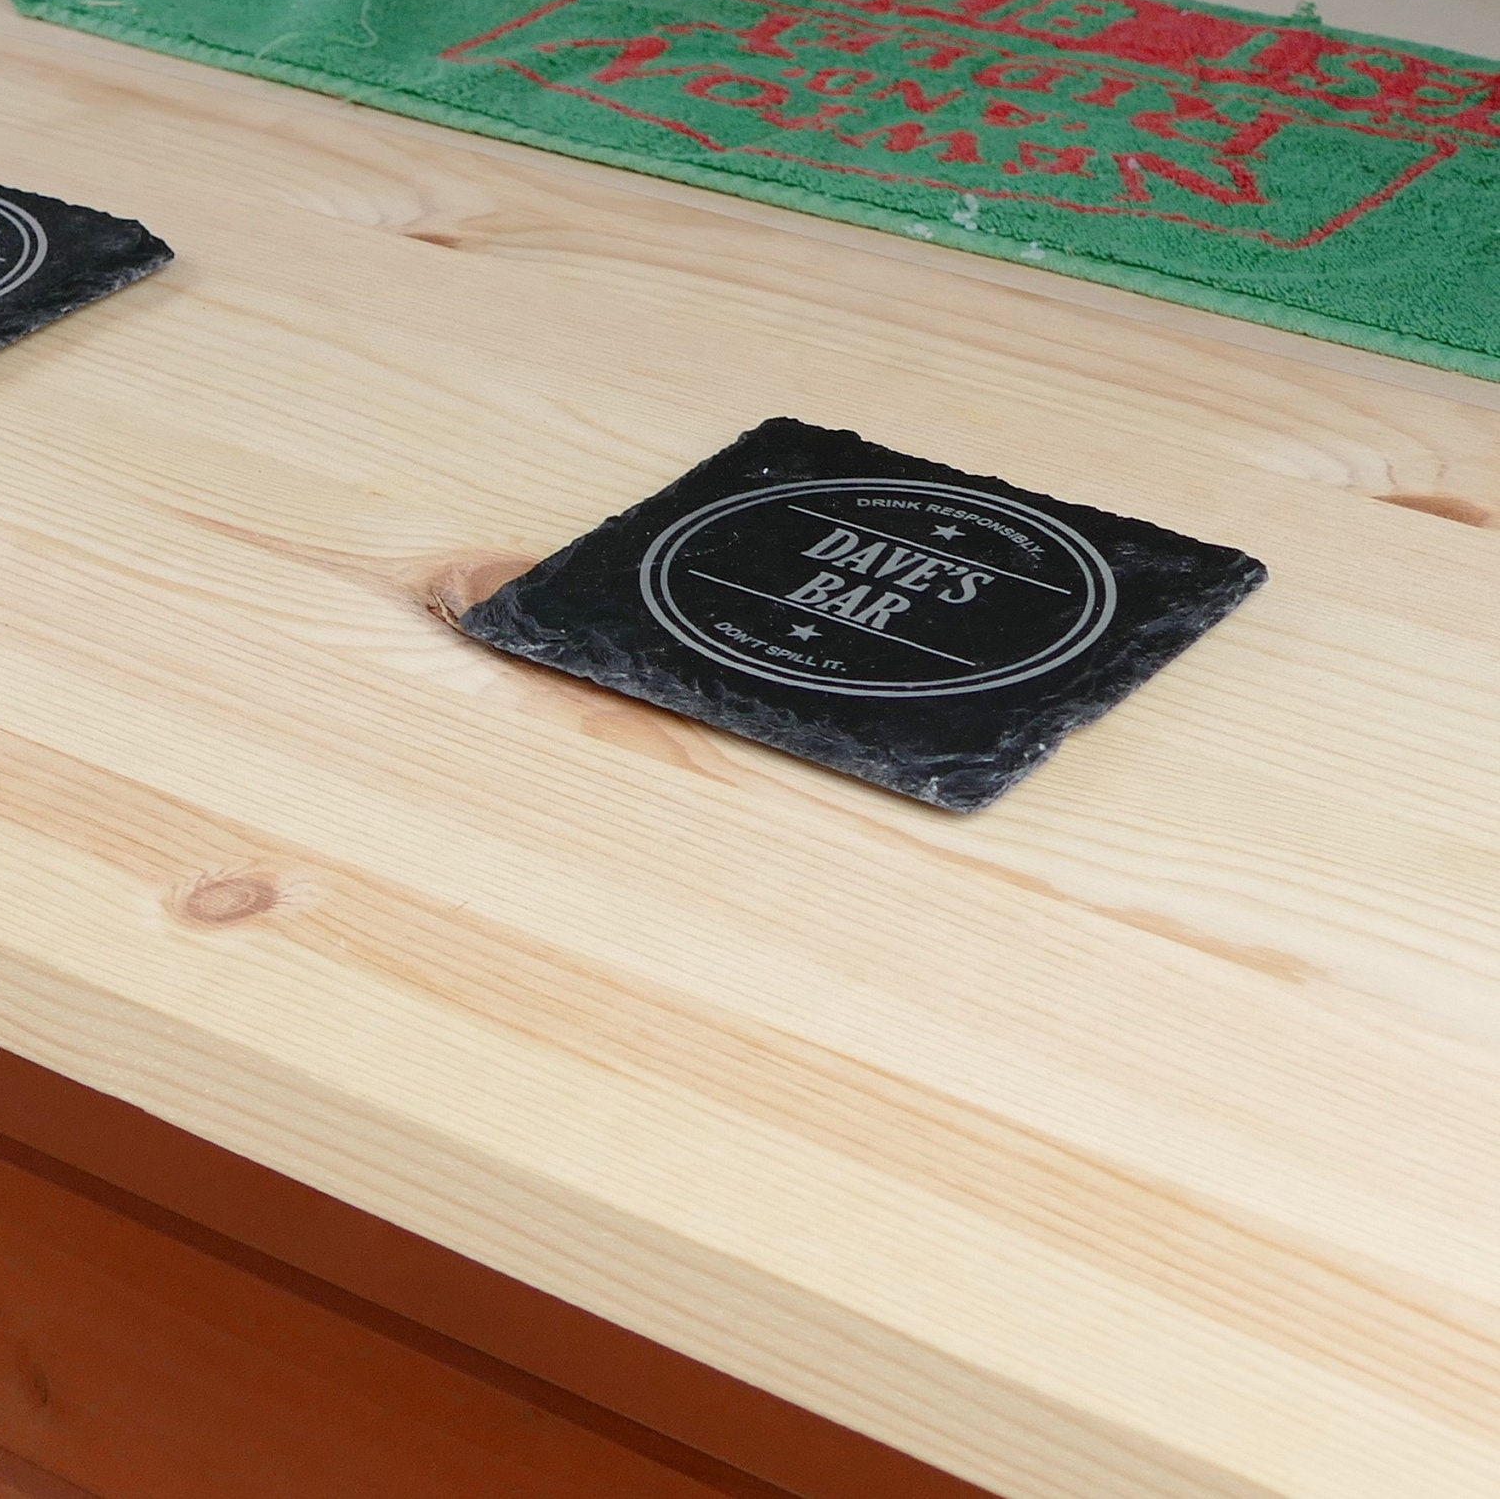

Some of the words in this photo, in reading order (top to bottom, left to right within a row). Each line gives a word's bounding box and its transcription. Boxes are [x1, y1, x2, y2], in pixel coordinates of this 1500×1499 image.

[669, 11, 1290, 161] RIDLEY
[856, 496, 921, 511] DRINK
[800, 527, 995, 604] DAVE'S
[785, 570, 911, 631] BAR
[713, 621, 768, 650] DON'T
[764, 645, 817, 667] SPILL
[820, 660, 848, 671] IT.
